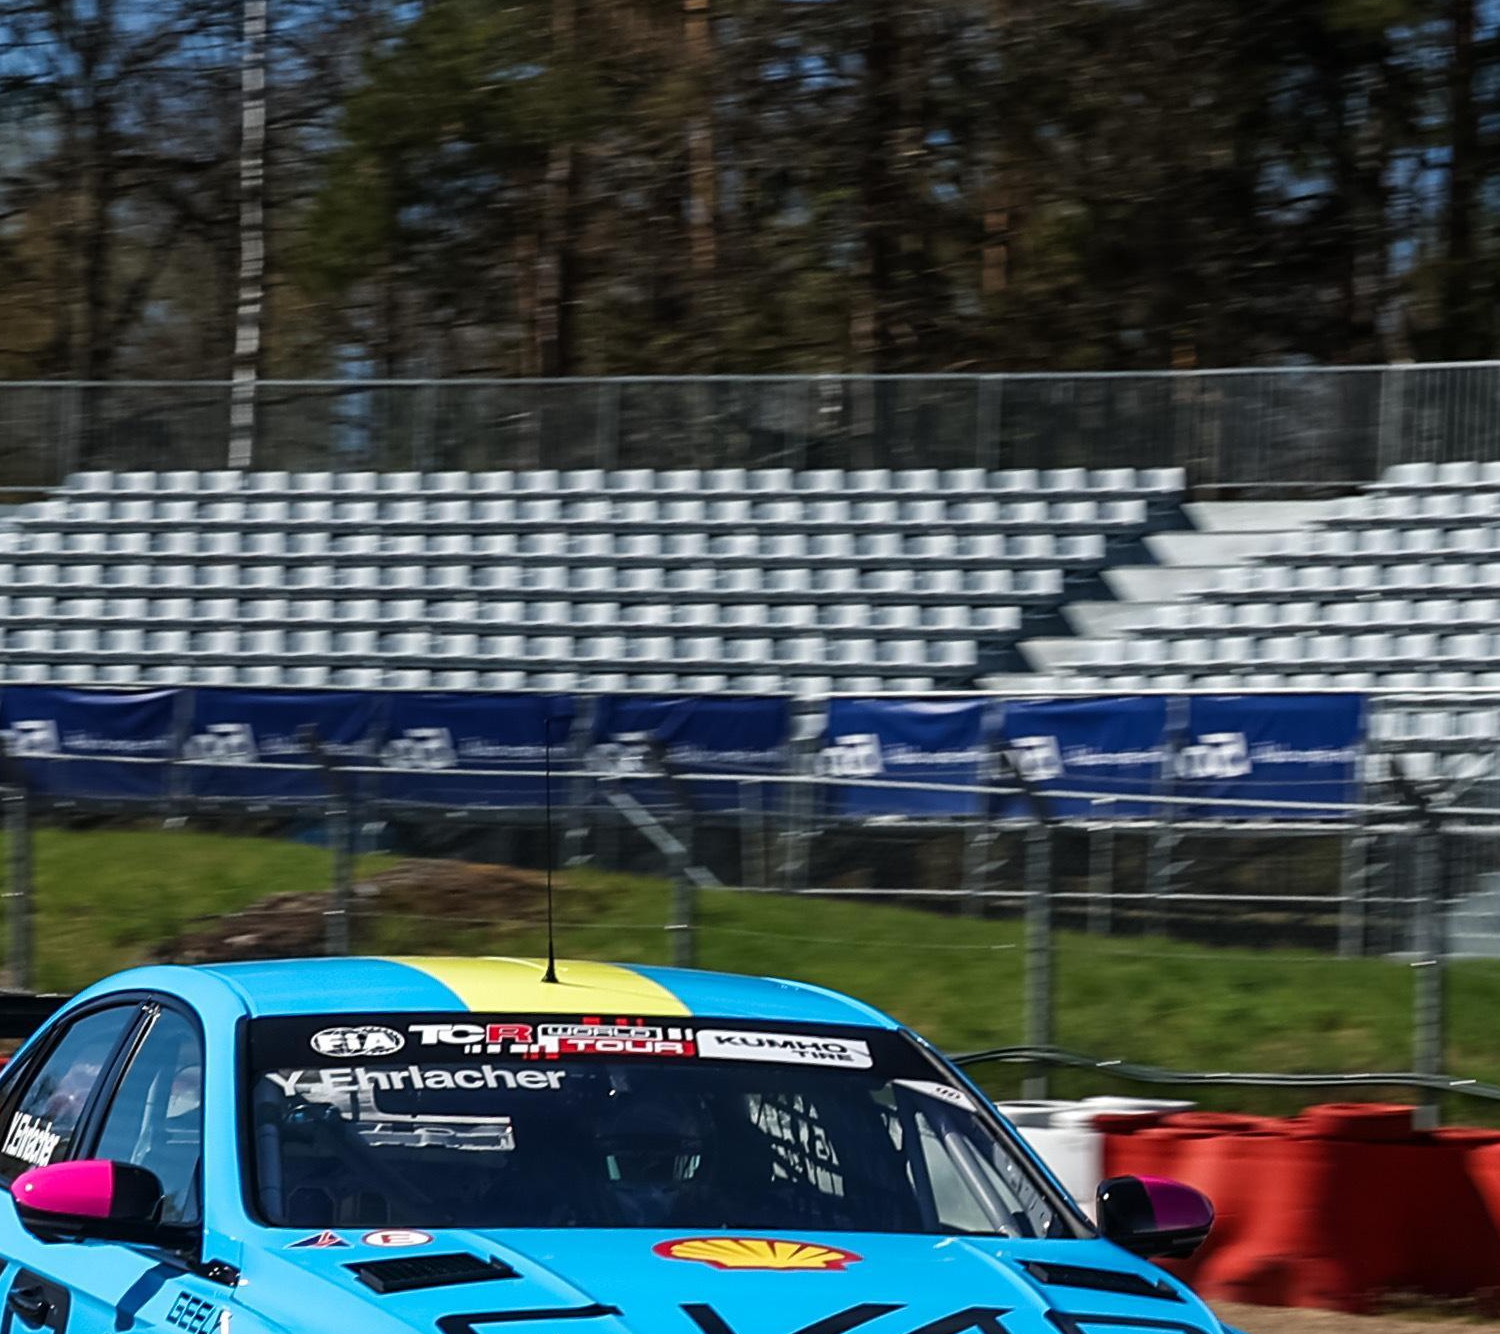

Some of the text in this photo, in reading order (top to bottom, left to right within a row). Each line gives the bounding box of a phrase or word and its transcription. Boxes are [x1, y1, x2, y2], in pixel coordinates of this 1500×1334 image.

[408, 1024, 533, 1045] TCR
[547, 1027, 651, 1038] WORLD
[315, 1030, 400, 1054] FIA
[566, 1039, 684, 1055] TOUR
[715, 1036, 848, 1054] KUMHO
[792, 1050, 855, 1063] TIRE
[319, 1065, 566, 1091] Ehrlacher
